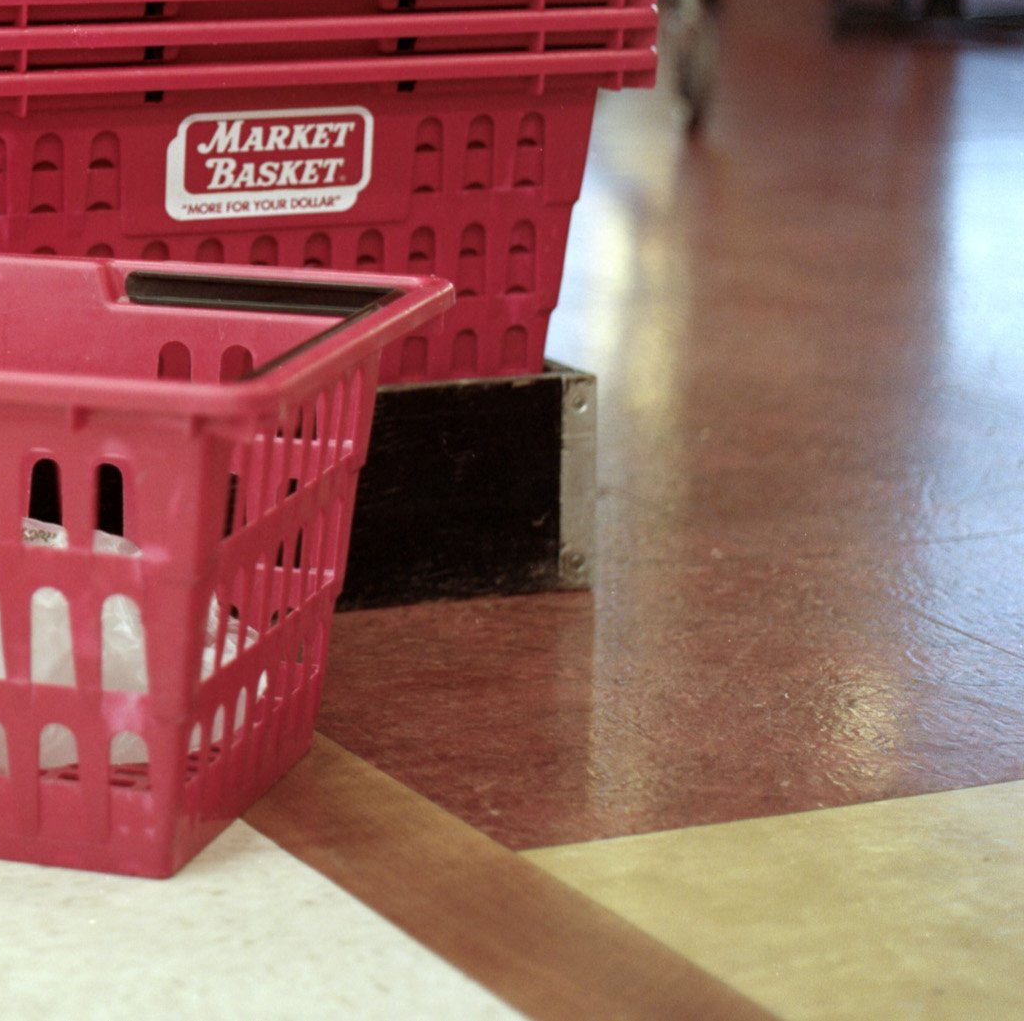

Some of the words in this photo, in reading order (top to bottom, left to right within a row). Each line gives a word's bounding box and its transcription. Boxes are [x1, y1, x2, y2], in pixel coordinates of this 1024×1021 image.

[197, 120, 355, 155] MARKET
[182, 201, 222, 215] "MORE
[226, 200, 250, 213] FOR
[254, 198, 286, 211] YOUR
[290, 195, 341, 209] DOLLAR"
